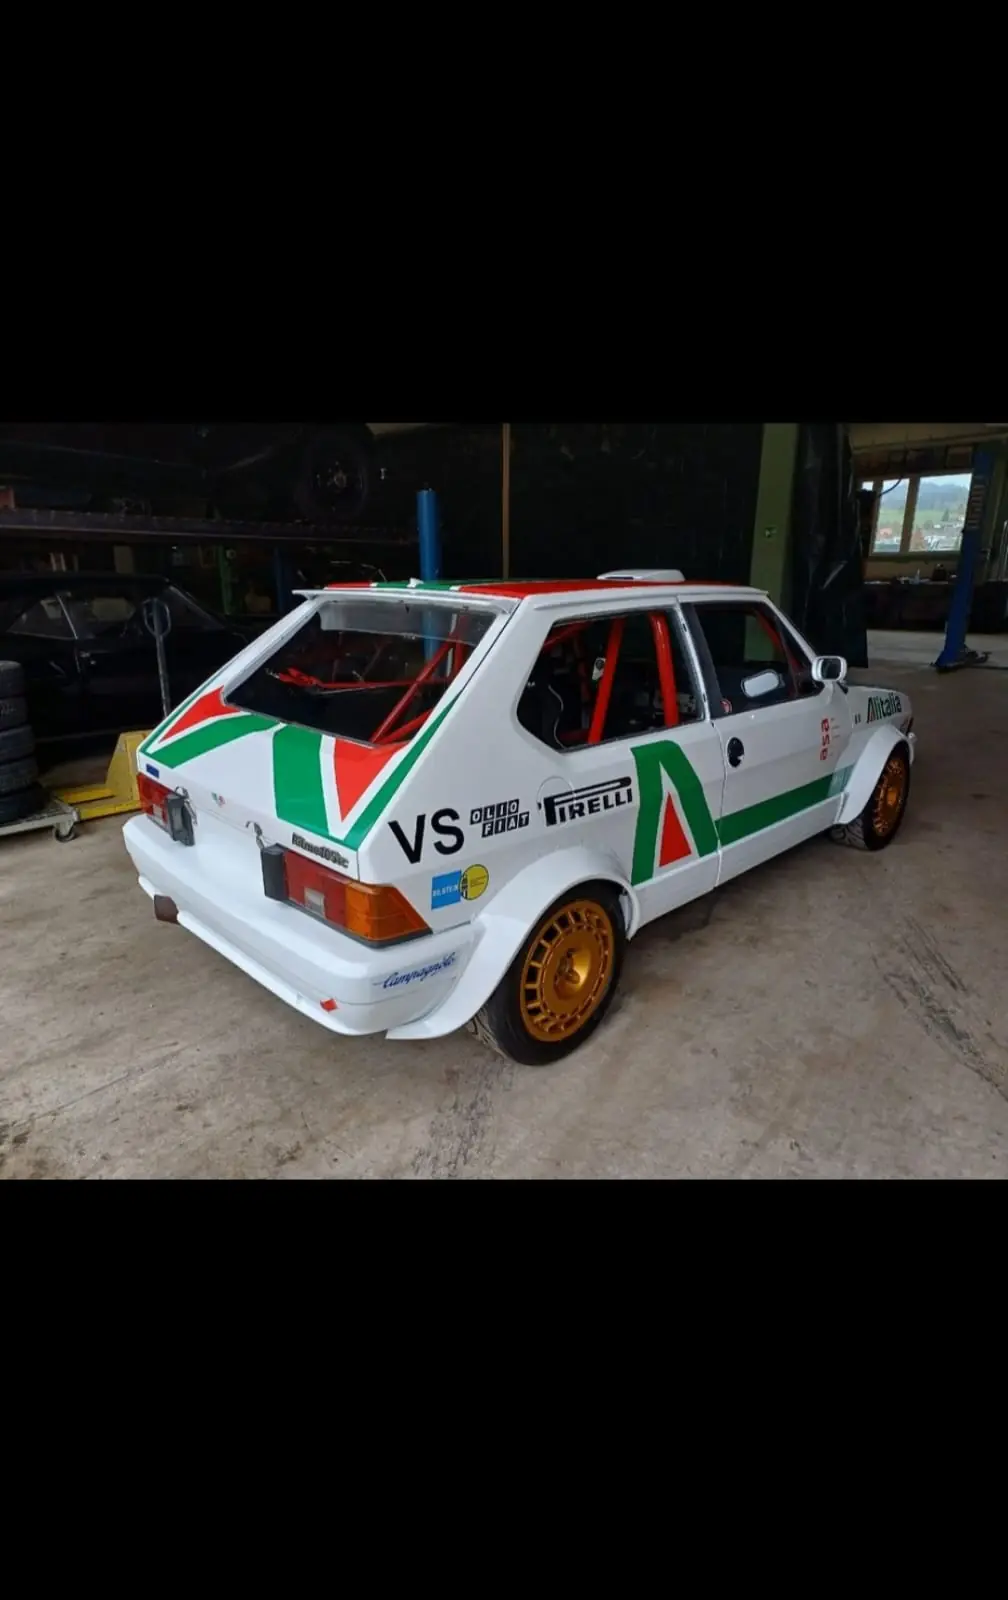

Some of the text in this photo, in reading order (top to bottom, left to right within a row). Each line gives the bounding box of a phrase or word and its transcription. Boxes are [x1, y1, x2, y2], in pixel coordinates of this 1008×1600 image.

[866, 691, 902, 724] Alitalia
[470, 798, 520, 825] OLIO
[542, 776, 633, 827] PIRELLI
[387, 808, 464, 864] VS
[482, 811, 530, 838] FIAT
